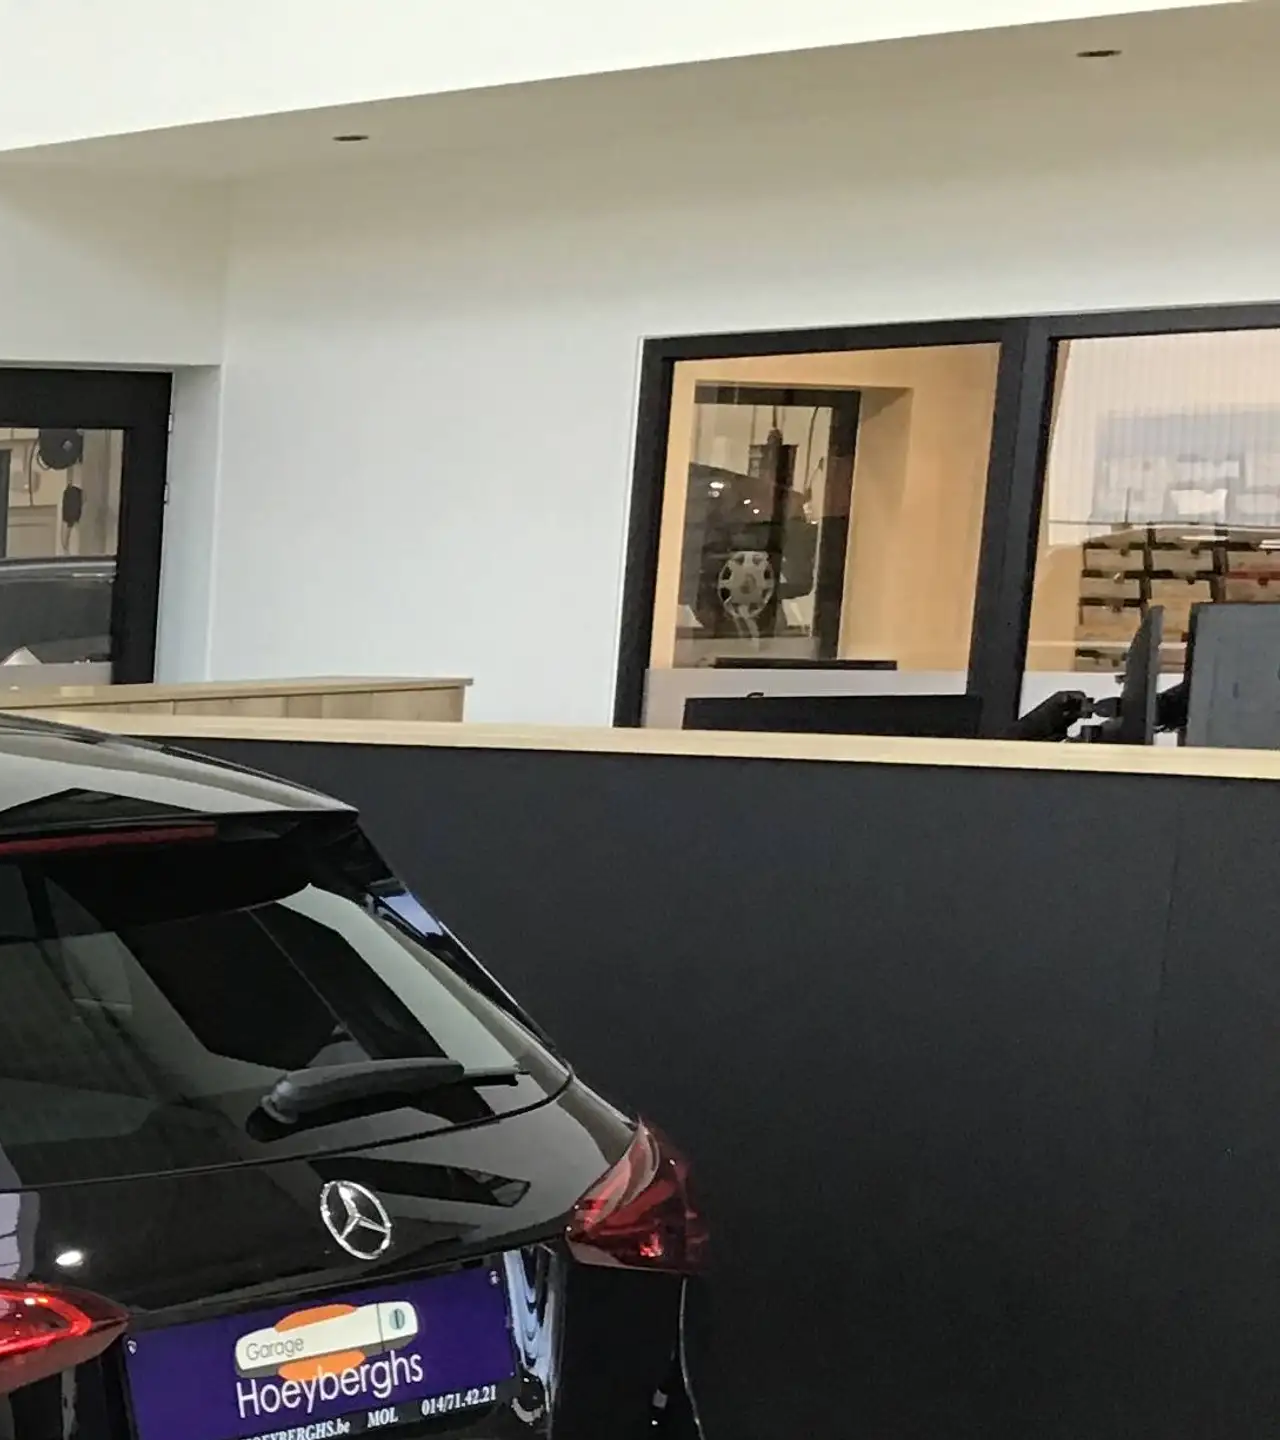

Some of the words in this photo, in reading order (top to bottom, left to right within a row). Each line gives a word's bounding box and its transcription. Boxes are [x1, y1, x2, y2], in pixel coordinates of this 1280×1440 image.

[246, 1337, 305, 1361] Garage
[236, 1350, 424, 1418] Hoeyberghs
[367, 1407, 398, 1429] MOL
[421, 1384, 497, 1416] 014/71.42.21
